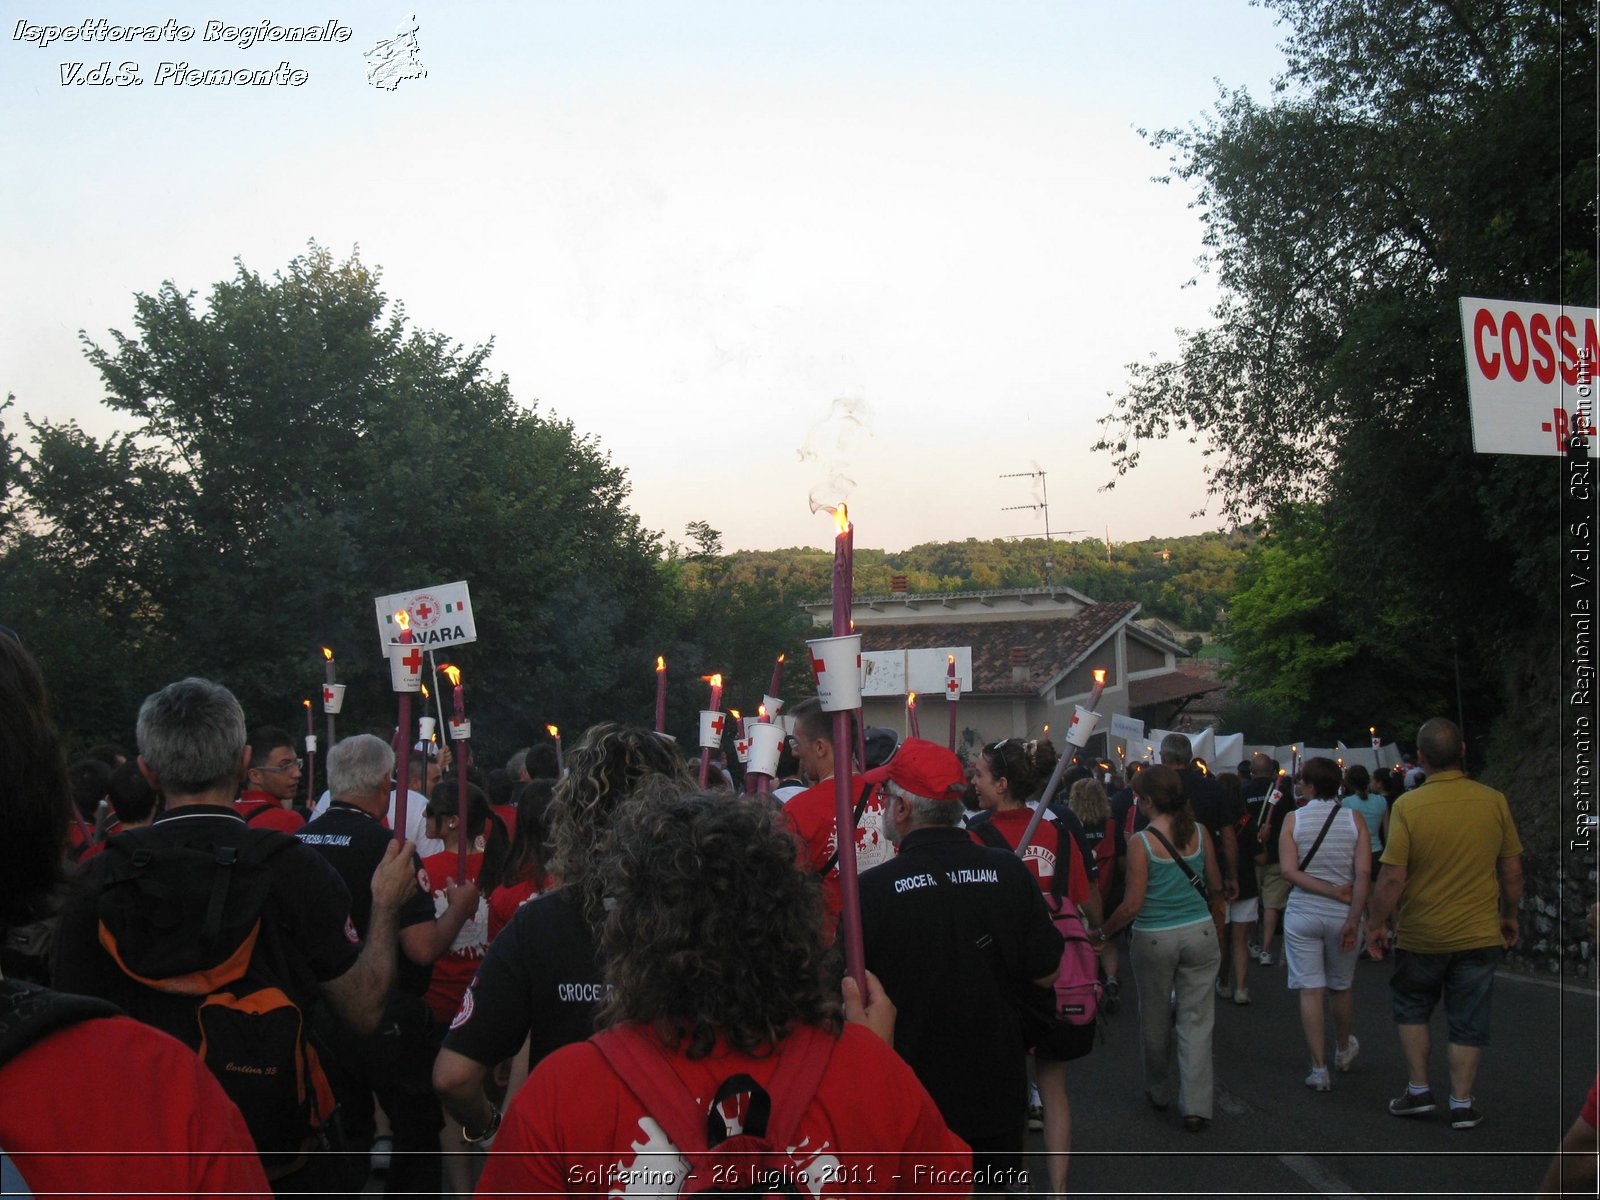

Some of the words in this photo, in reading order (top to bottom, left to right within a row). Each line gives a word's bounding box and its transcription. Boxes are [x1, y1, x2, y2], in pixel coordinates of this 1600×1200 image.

[894, 874, 928, 893] CROCE
[957, 869, 998, 883] ITALIANA
[559, 984, 601, 1002] CROCE
